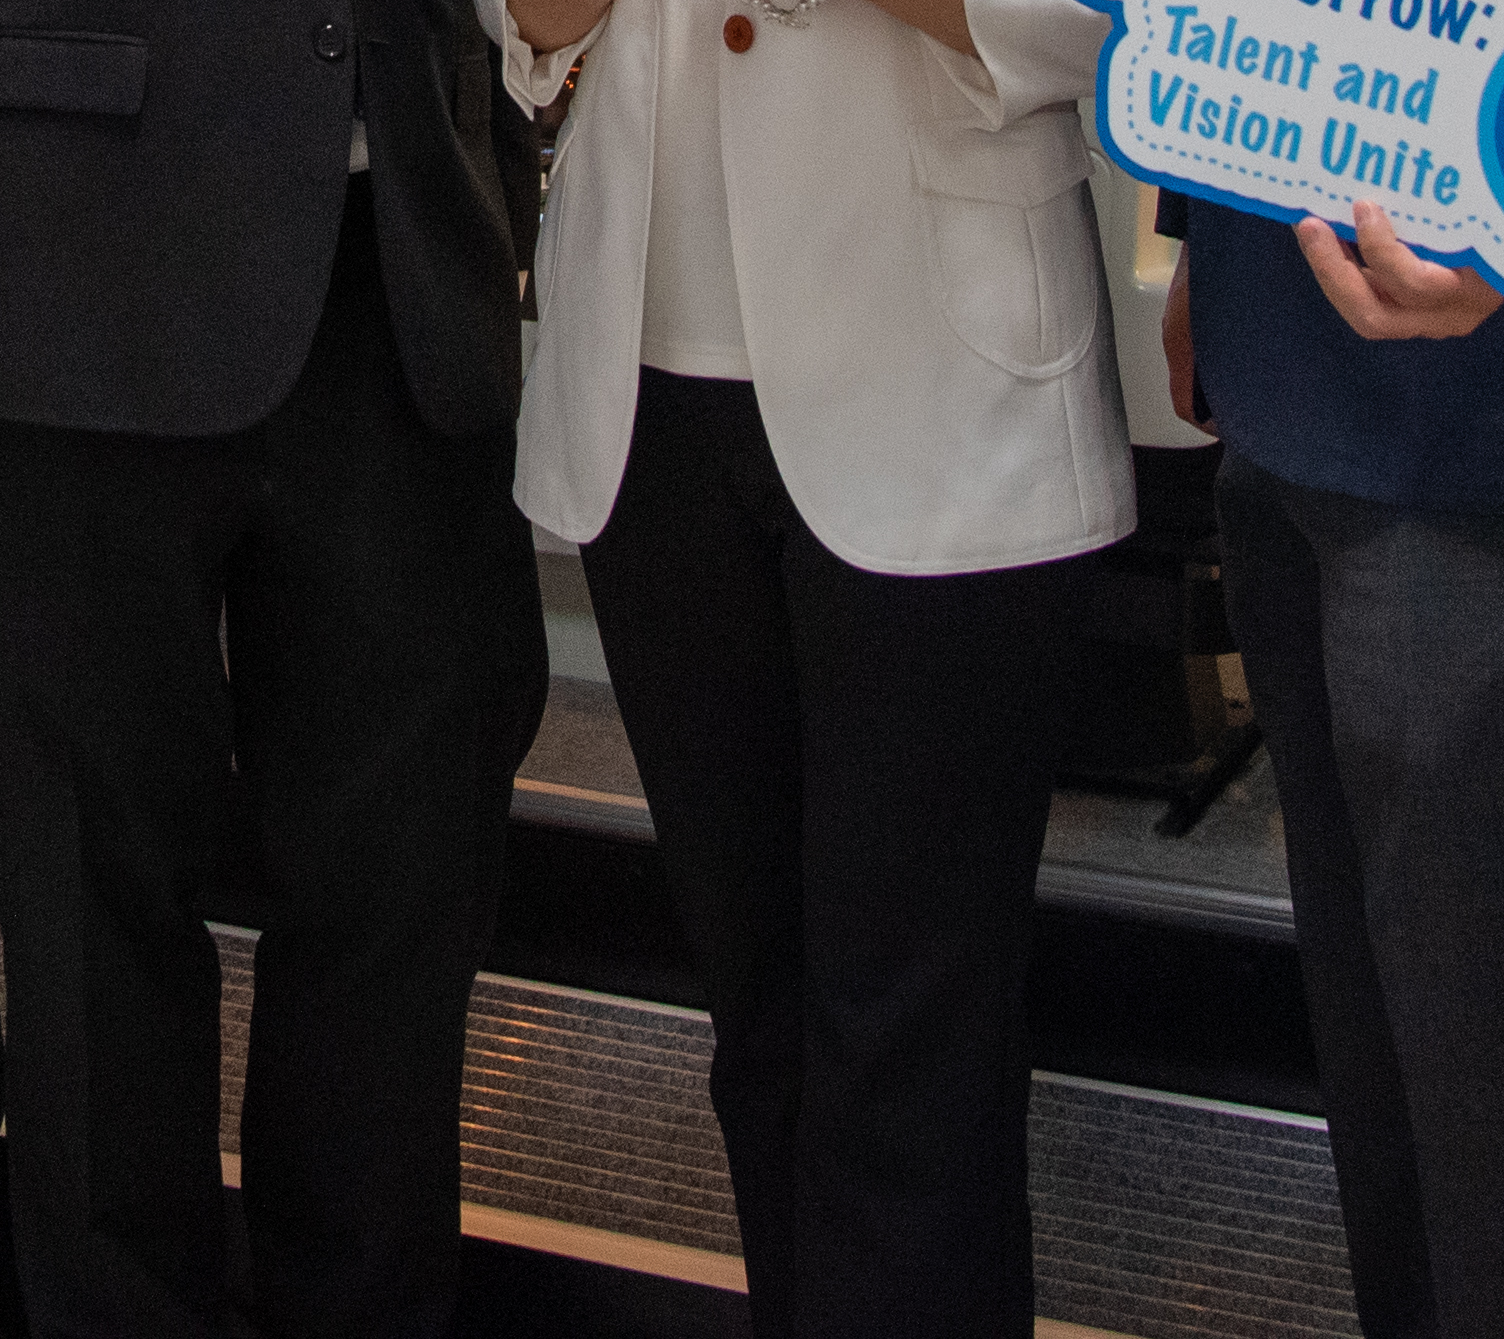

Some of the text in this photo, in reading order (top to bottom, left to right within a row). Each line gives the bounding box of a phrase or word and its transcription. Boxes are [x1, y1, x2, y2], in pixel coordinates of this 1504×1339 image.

[1165, 4, 1438, 125] Talent and
[1147, 70, 1463, 208] Vision Unite
